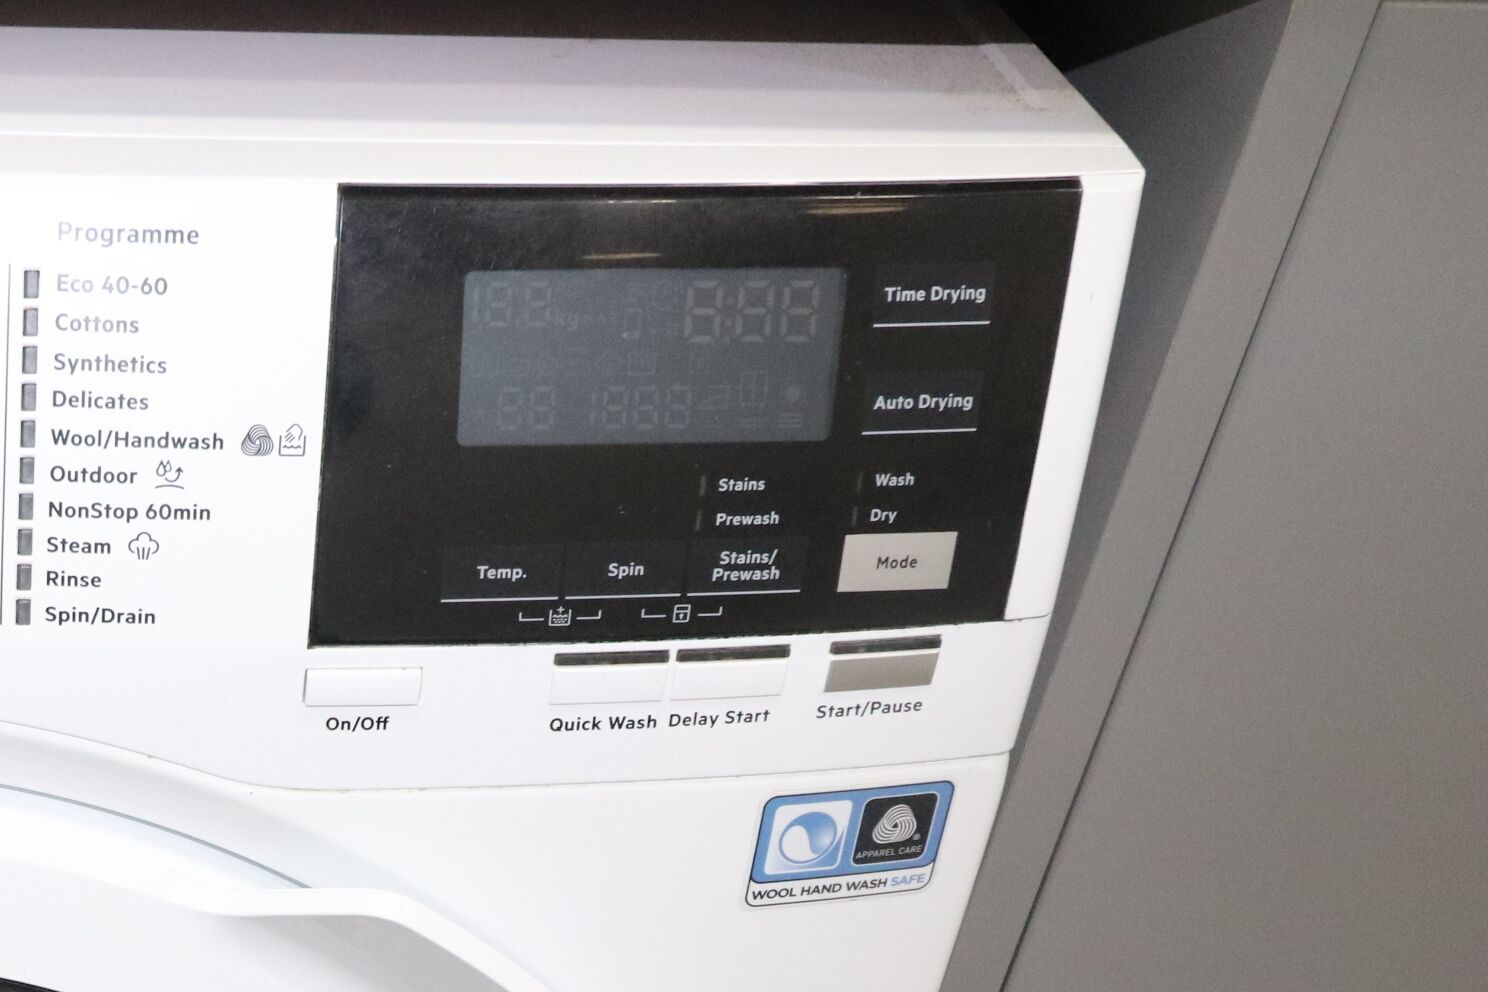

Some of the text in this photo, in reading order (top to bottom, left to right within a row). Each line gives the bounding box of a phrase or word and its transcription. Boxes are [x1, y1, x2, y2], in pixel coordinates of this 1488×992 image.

[57, 221, 200, 248] Programme
[56, 273, 168, 296] Eco 40-60
[884, 284, 987, 306] Time Drying
[54, 313, 140, 334] Cottons
[53, 352, 168, 376] Synthetics
[51, 389, 150, 411] Delicates
[873, 392, 974, 414] Auto Drying
[50, 428, 225, 451] Wool/Handwash
[49, 464, 139, 485] Outdoor
[717, 476, 766, 493] Stains
[874, 472, 915, 488] Wash
[48, 501, 212, 524] NonStop 60min
[715, 510, 780, 527] Prewash
[869, 507, 898, 524] Dry
[46, 536, 112, 555] Steam
[718, 548, 778, 567] Stains/
[876, 554, 918, 571] Mode
[45, 570, 102, 588] Rinse
[477, 564, 527, 583] Temp.
[607, 561, 645, 580] Spin
[711, 565, 781, 583] Prewash
[44, 606, 157, 626] Spin/Drain
[815, 697, 923, 720] Start/Pause
[325, 715, 390, 733] On/Off
[548, 713, 658, 734] Quick Wash
[668, 708, 771, 730] Delay Start
[855, 844, 923, 860] APPAREL CARE
[752, 872, 927, 901] WOOL HAND WASH SAFE
